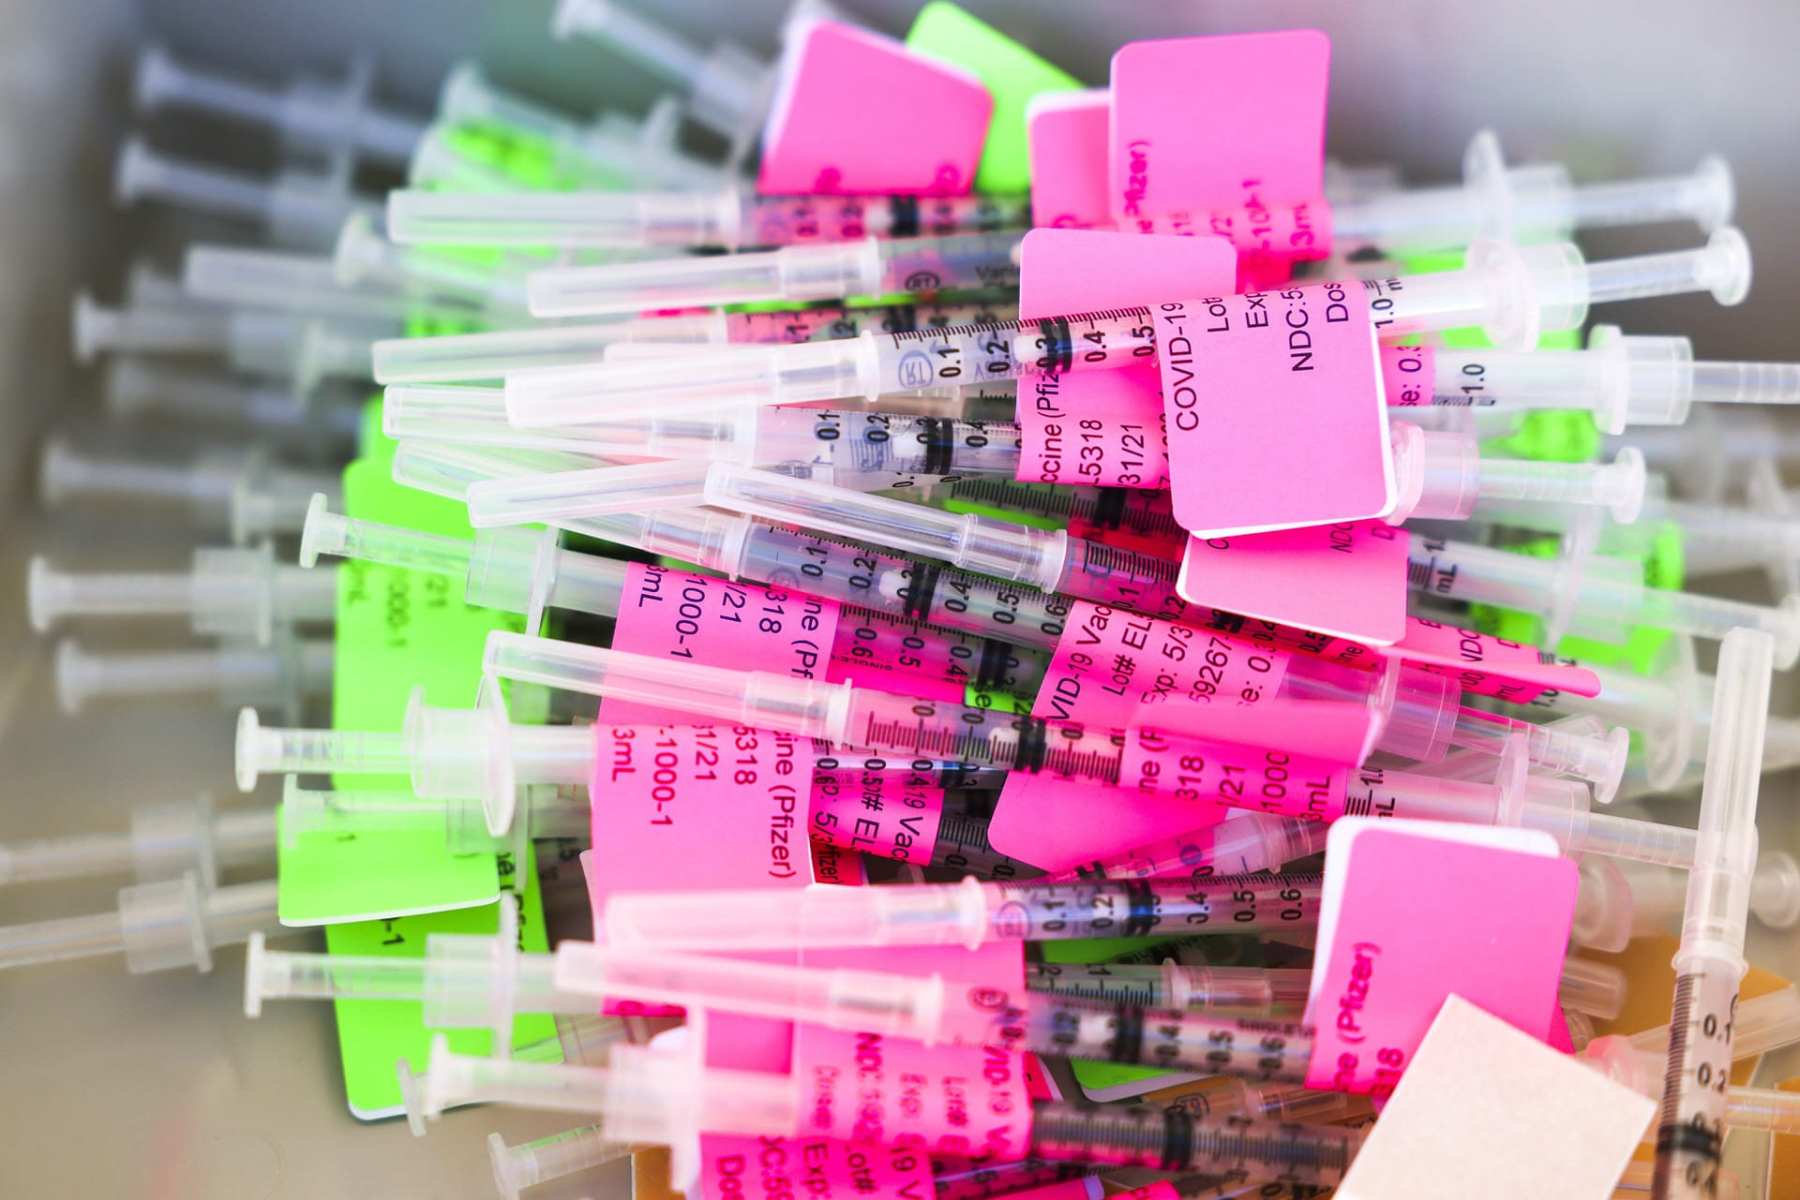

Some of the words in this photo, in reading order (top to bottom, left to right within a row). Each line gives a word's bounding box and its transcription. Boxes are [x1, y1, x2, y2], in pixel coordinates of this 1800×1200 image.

[1372, 298, 1394, 328] 1.0
[987, 340, 1010, 373] 0.2
[1083, 330, 1107, 363] 0.4
[1131, 325, 1155, 358] 0.5
[938, 347, 961, 378] 0.1
[1161, 301, 1199, 431] COVID-19
[1462, 363, 1485, 394] 1.0
[816, 413, 840, 441] 0.1
[867, 415, 890, 443] 0.2
[965, 421, 989, 448] 0.4
[801, 544, 829, 577] 0.1
[849, 556, 878, 590] 0.2
[944, 579, 972, 613] 0.4
[992, 590, 1021, 625] 0.5
[1040, 603, 1069, 636] 0.6
[612, 728, 636, 783] 3mL
[768, 784, 797, 879] (Pfizer)
[1233, 890, 1256, 923] 0.5
[1279, 888, 1303, 921] 0.6
